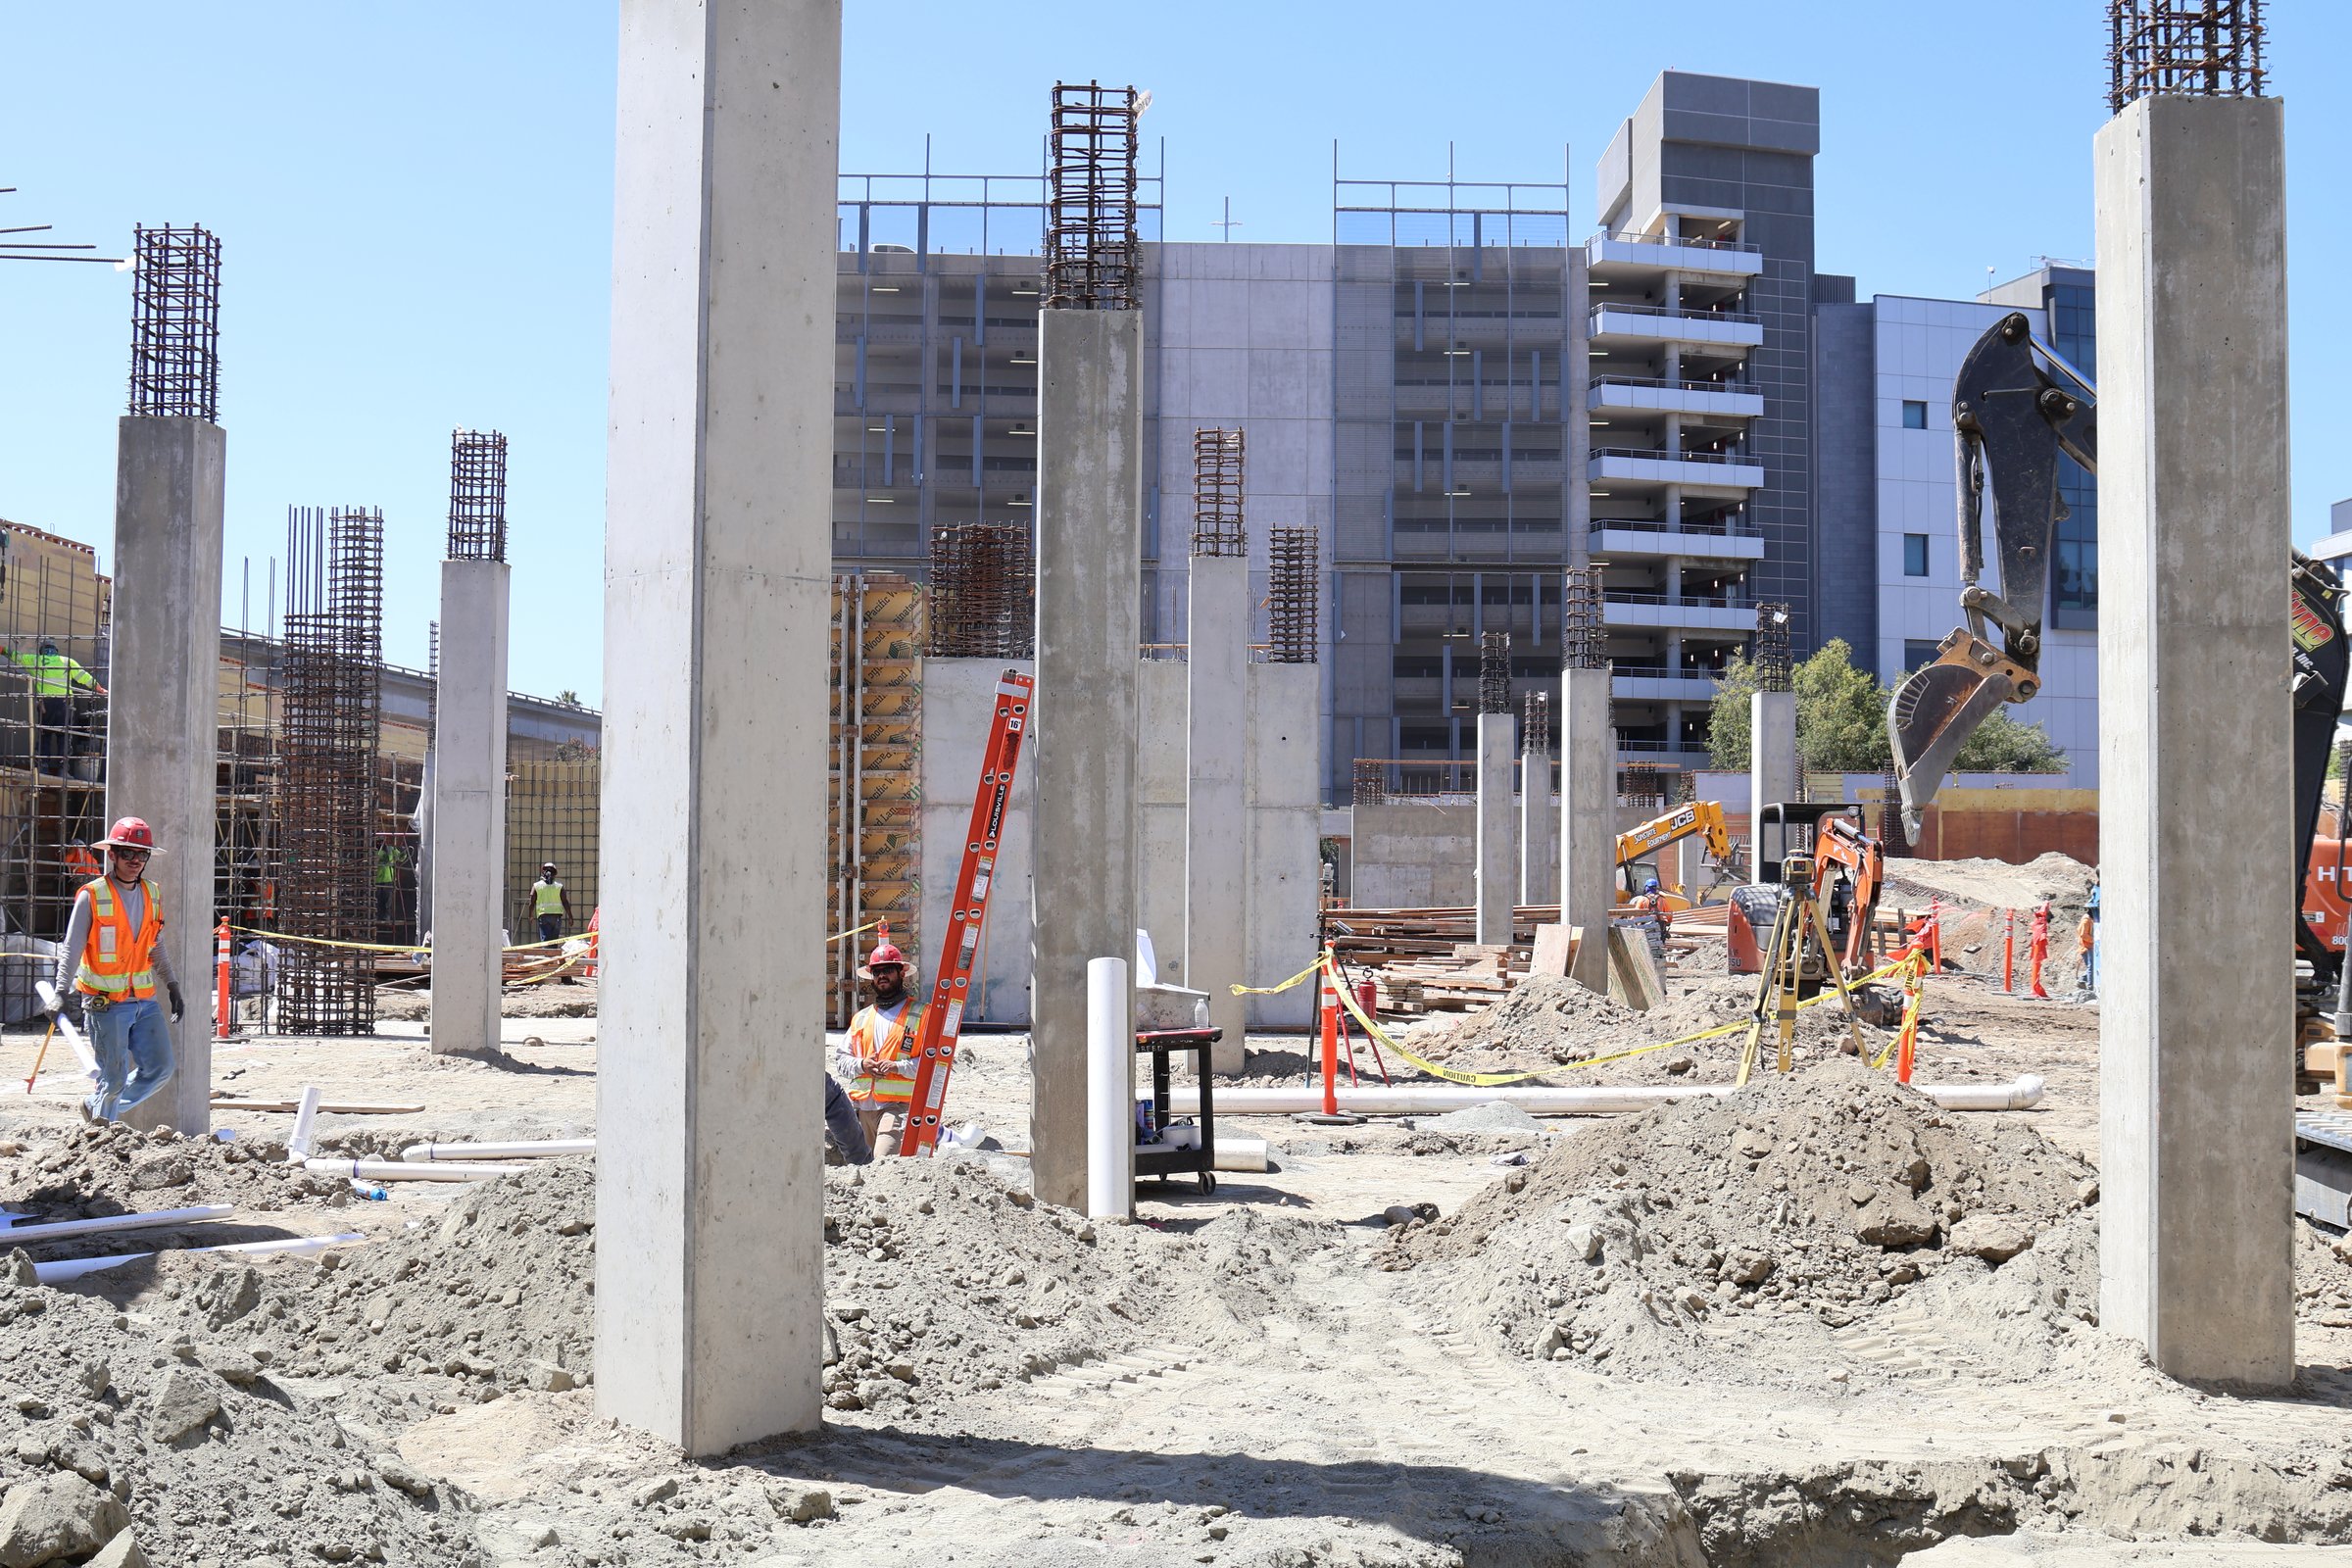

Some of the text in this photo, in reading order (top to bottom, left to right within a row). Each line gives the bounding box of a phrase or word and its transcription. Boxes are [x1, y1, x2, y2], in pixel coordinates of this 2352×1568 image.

[865, 595, 890, 620] Pacific
[863, 630, 886, 653] Wood
[2295, 653, 2314, 669] Inc.
[862, 724, 885, 744] Wood
[991, 785, 1005, 832] LOUISVILLE
[1671, 810, 1694, 830] JCB
[1646, 832, 1671, 847] EQUIPMENT
